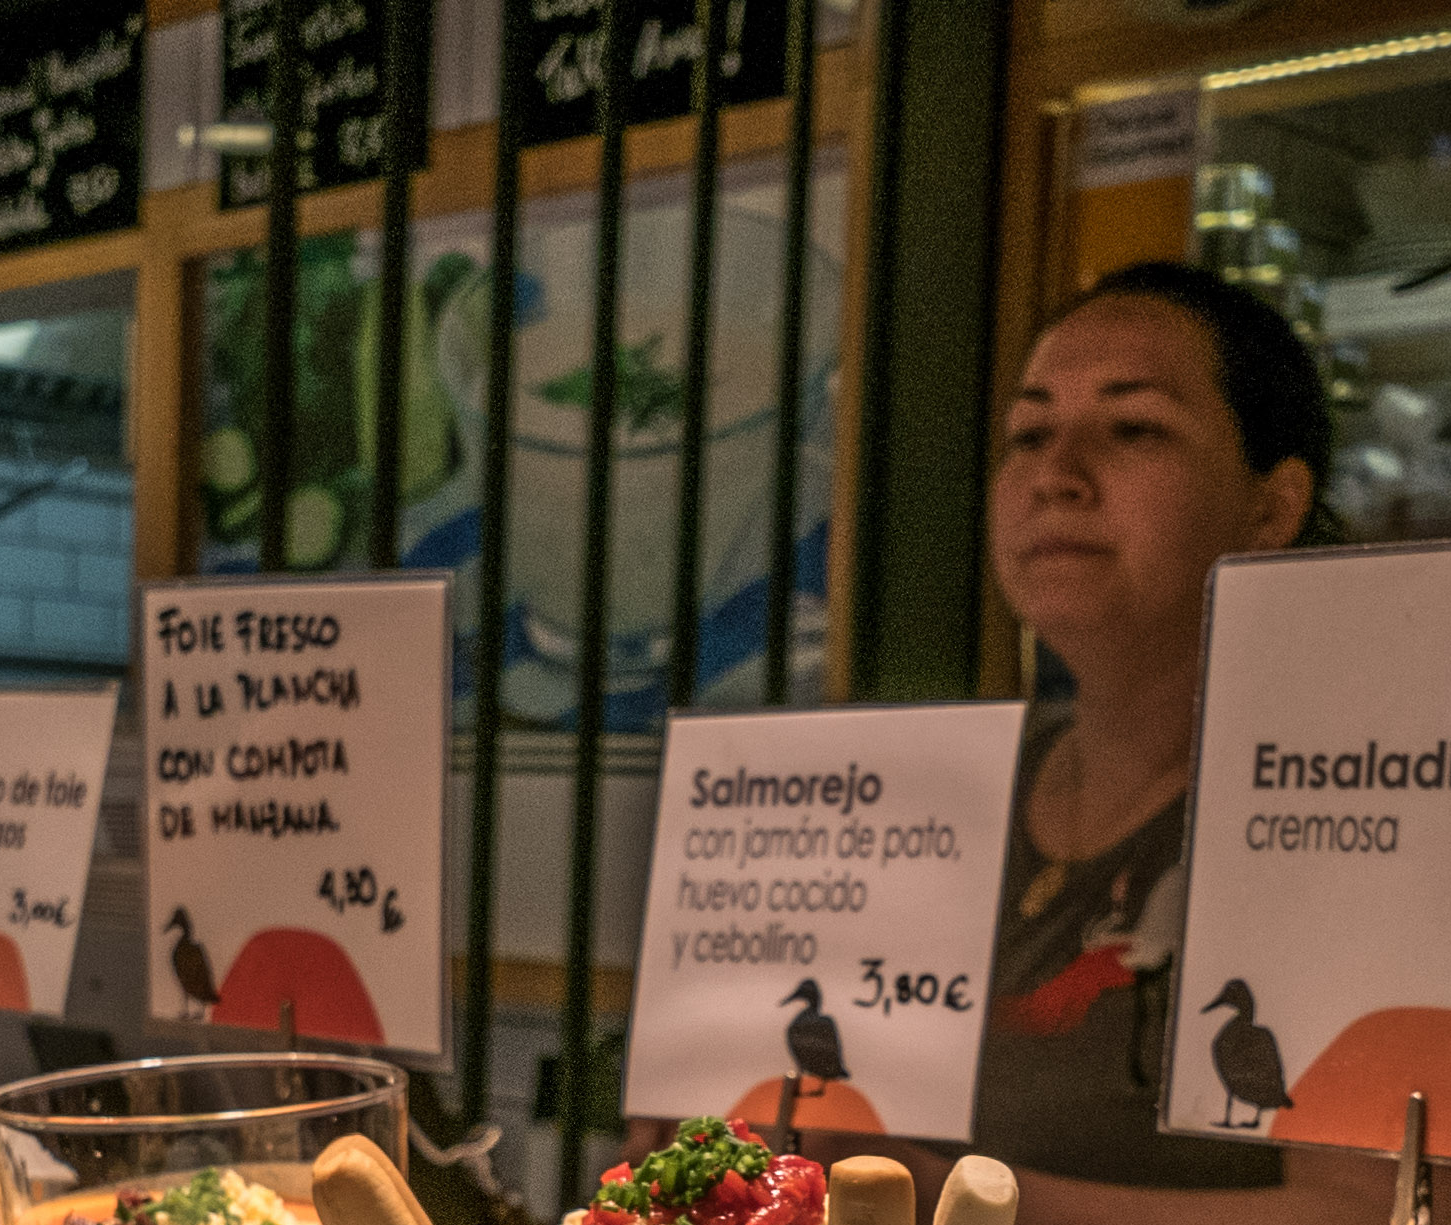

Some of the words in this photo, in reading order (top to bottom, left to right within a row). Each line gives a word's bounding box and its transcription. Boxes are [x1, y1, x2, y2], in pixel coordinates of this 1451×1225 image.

[158, 607, 226, 656] FOIE
[235, 610, 341, 654] FRESCO
[162, 679, 180, 718] A
[194, 682, 225, 718] LA
[236, 667, 362, 713] PLANCHA
[159, 746, 215, 784] CON
[226, 737, 348, 780] COMPOTA
[9, 770, 41, 807] de
[690, 762, 884, 815] Salmorejo
[160, 806, 195, 840] DE
[683, 826, 737, 861] con
[737, 814, 829, 868] jamón
[835, 819, 877, 861] de
[881, 817, 963, 868] pato,
[1246, 811, 1399, 853] cremosa
[677, 872, 761, 912] huevo
[767, 869, 868, 913] cocido
[670, 930, 689, 971] y
[693, 923, 817, 965] cebollino
